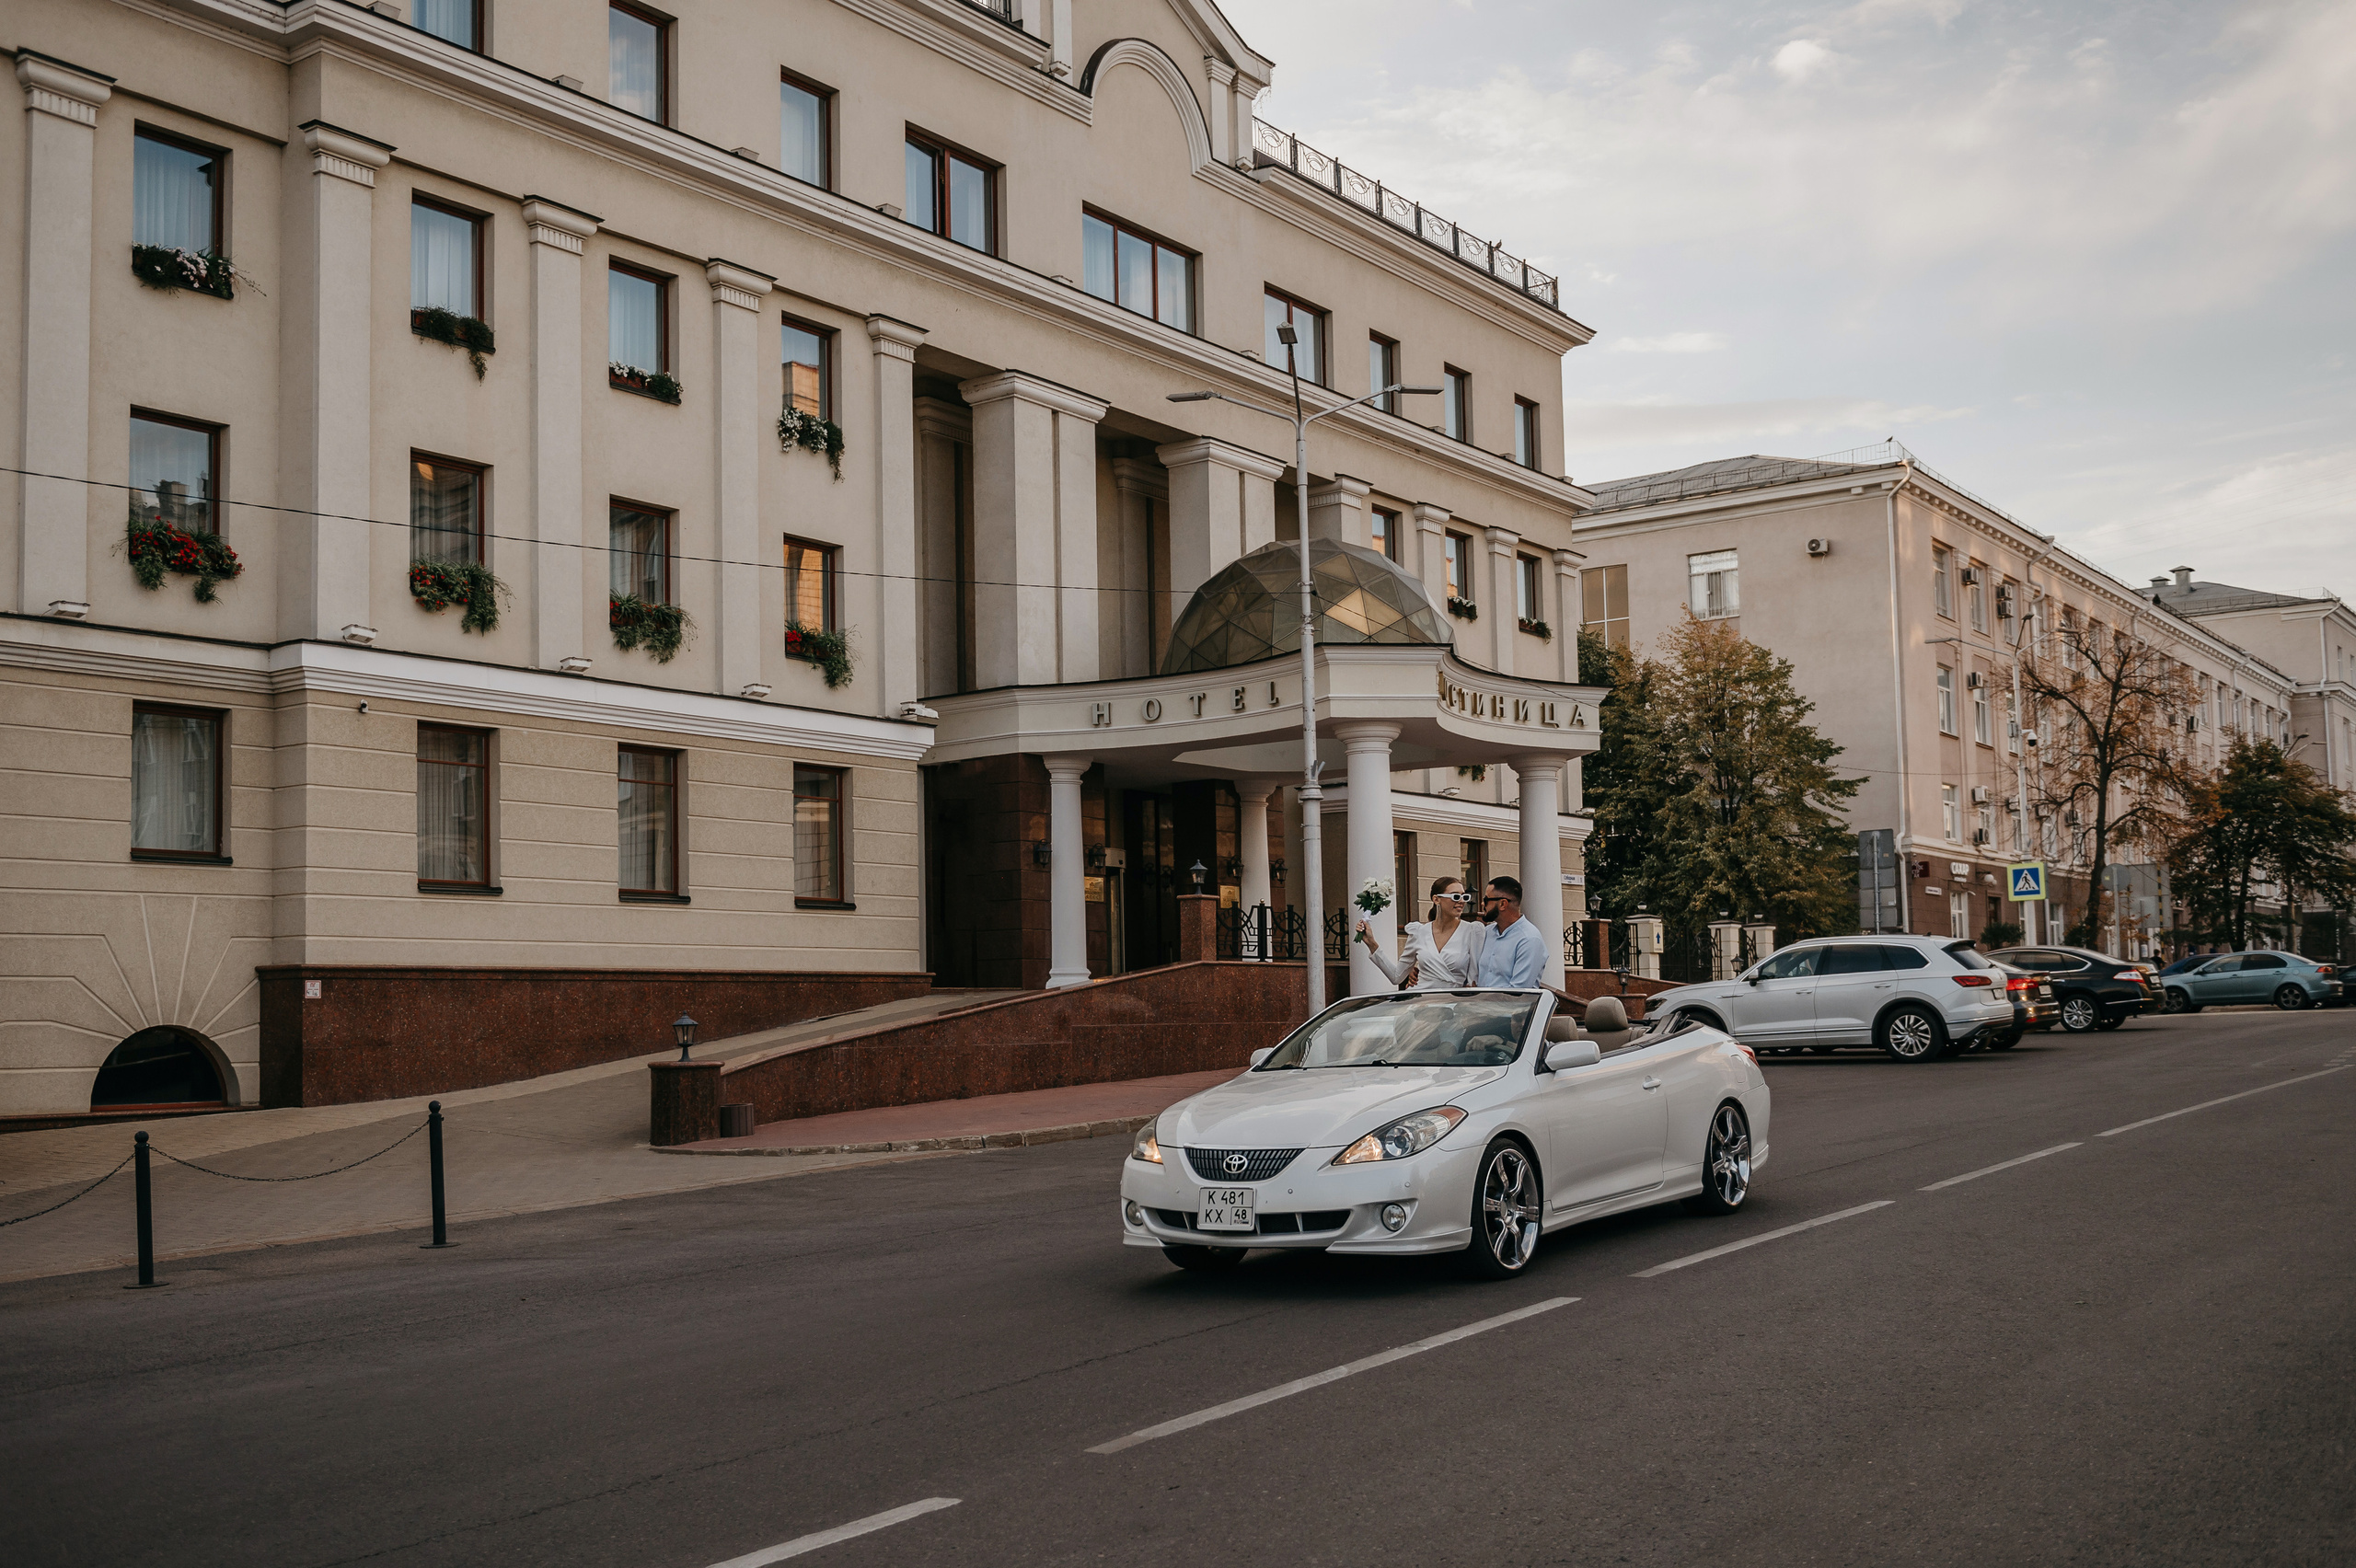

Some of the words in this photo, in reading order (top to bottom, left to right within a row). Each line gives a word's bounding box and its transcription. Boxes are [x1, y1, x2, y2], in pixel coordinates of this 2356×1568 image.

[1091, 681, 1279, 726] HOTEL
[1438, 671, 1588, 729] СТИНИЦА
[1207, 1191, 1216, 1205] К
[1220, 1191, 1244, 1205] 481
[1205, 1208, 1223, 1223] КХ
[1234, 1208, 1247, 1219] 48
